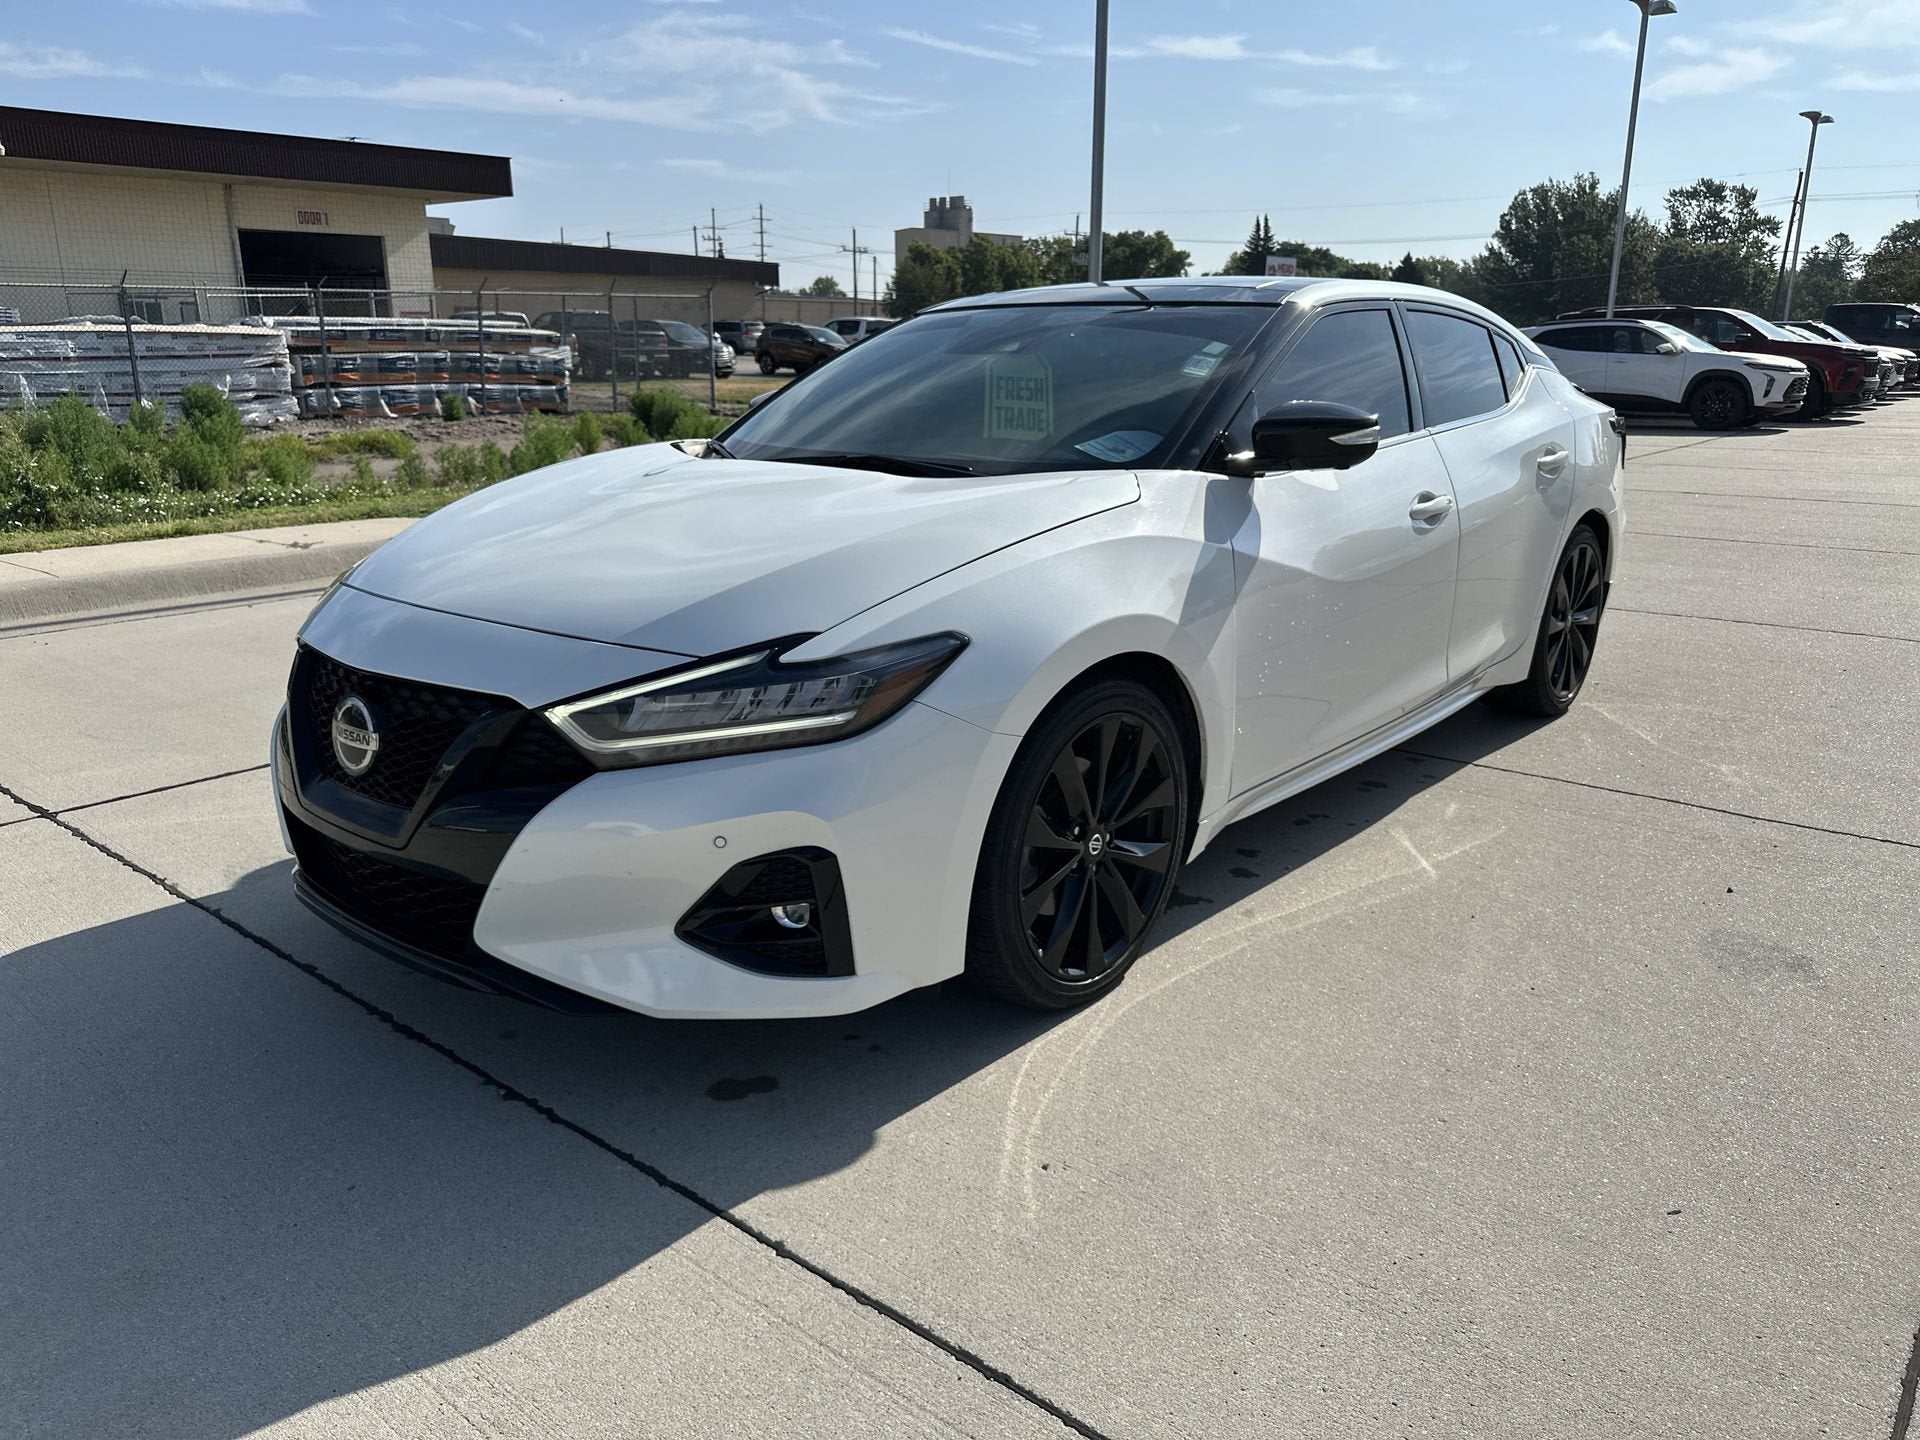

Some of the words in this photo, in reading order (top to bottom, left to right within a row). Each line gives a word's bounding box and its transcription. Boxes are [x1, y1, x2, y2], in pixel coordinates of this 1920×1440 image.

[297, 210, 322, 225] DOOR
[995, 376, 1045, 402] FRESH
[994, 406, 1045, 433] TRADE
[336, 725, 370, 746] NISSAN
